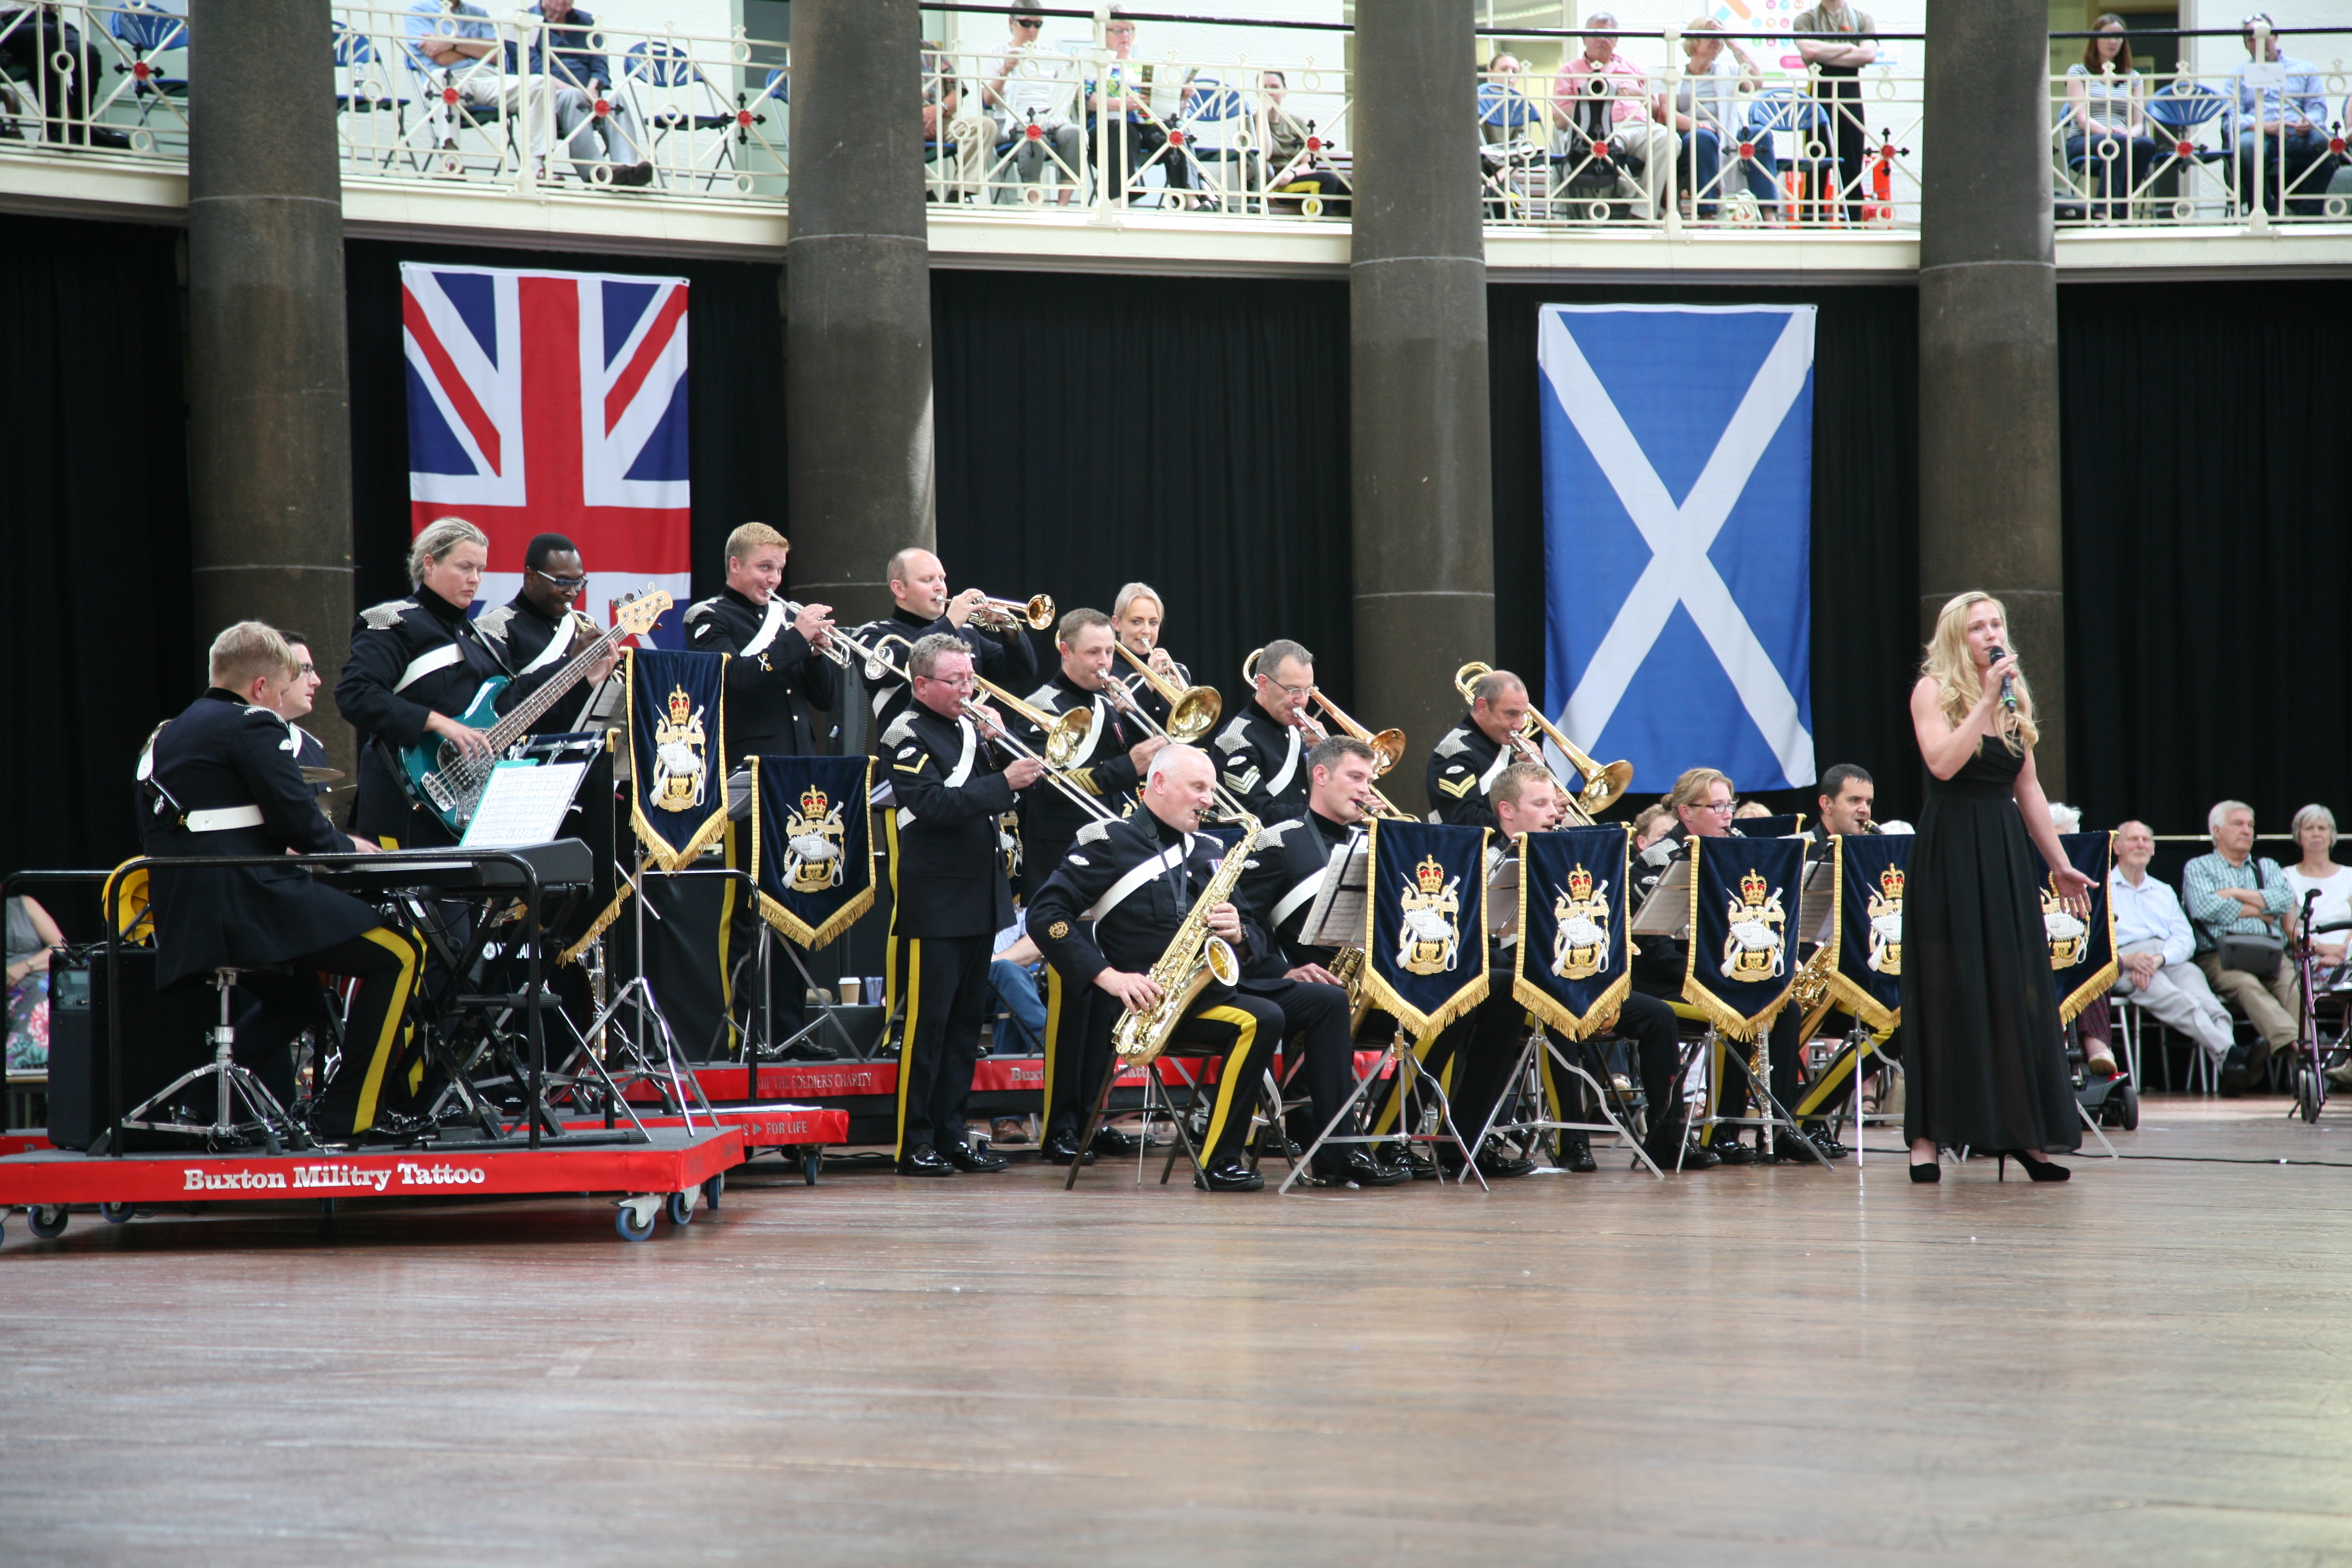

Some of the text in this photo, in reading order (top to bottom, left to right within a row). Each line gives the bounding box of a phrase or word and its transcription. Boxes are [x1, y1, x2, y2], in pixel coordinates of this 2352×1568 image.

[774, 1076, 790, 1089] THE
[835, 1072, 871, 1088] CHARITY
[766, 1121, 808, 1135] FOR LIFE
[183, 1163, 485, 1192] Buxton Militry Tattoo
